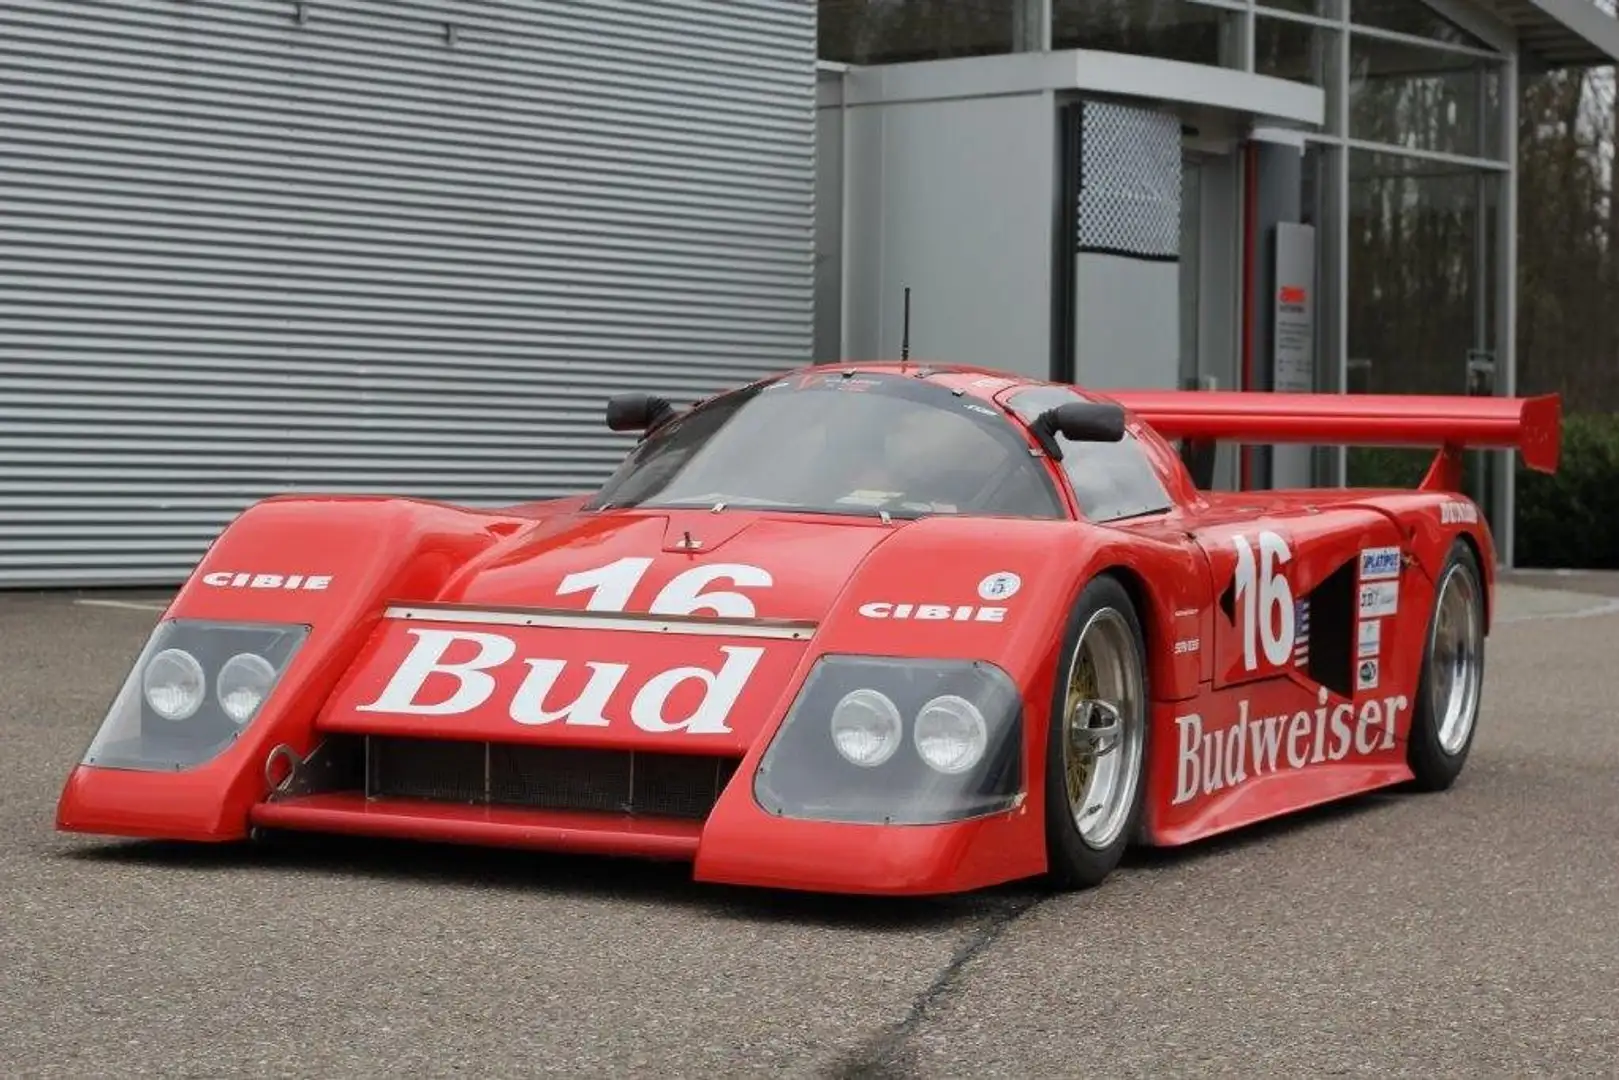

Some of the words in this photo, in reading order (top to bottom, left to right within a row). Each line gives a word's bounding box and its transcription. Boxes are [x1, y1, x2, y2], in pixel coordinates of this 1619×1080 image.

[202, 572, 334, 590] CIBIE
[858, 602, 1007, 622] CIBIE
[1235, 532, 1294, 671] 16
[355, 629, 765, 734] Bud
[1173, 688, 1407, 804] Budweiser
